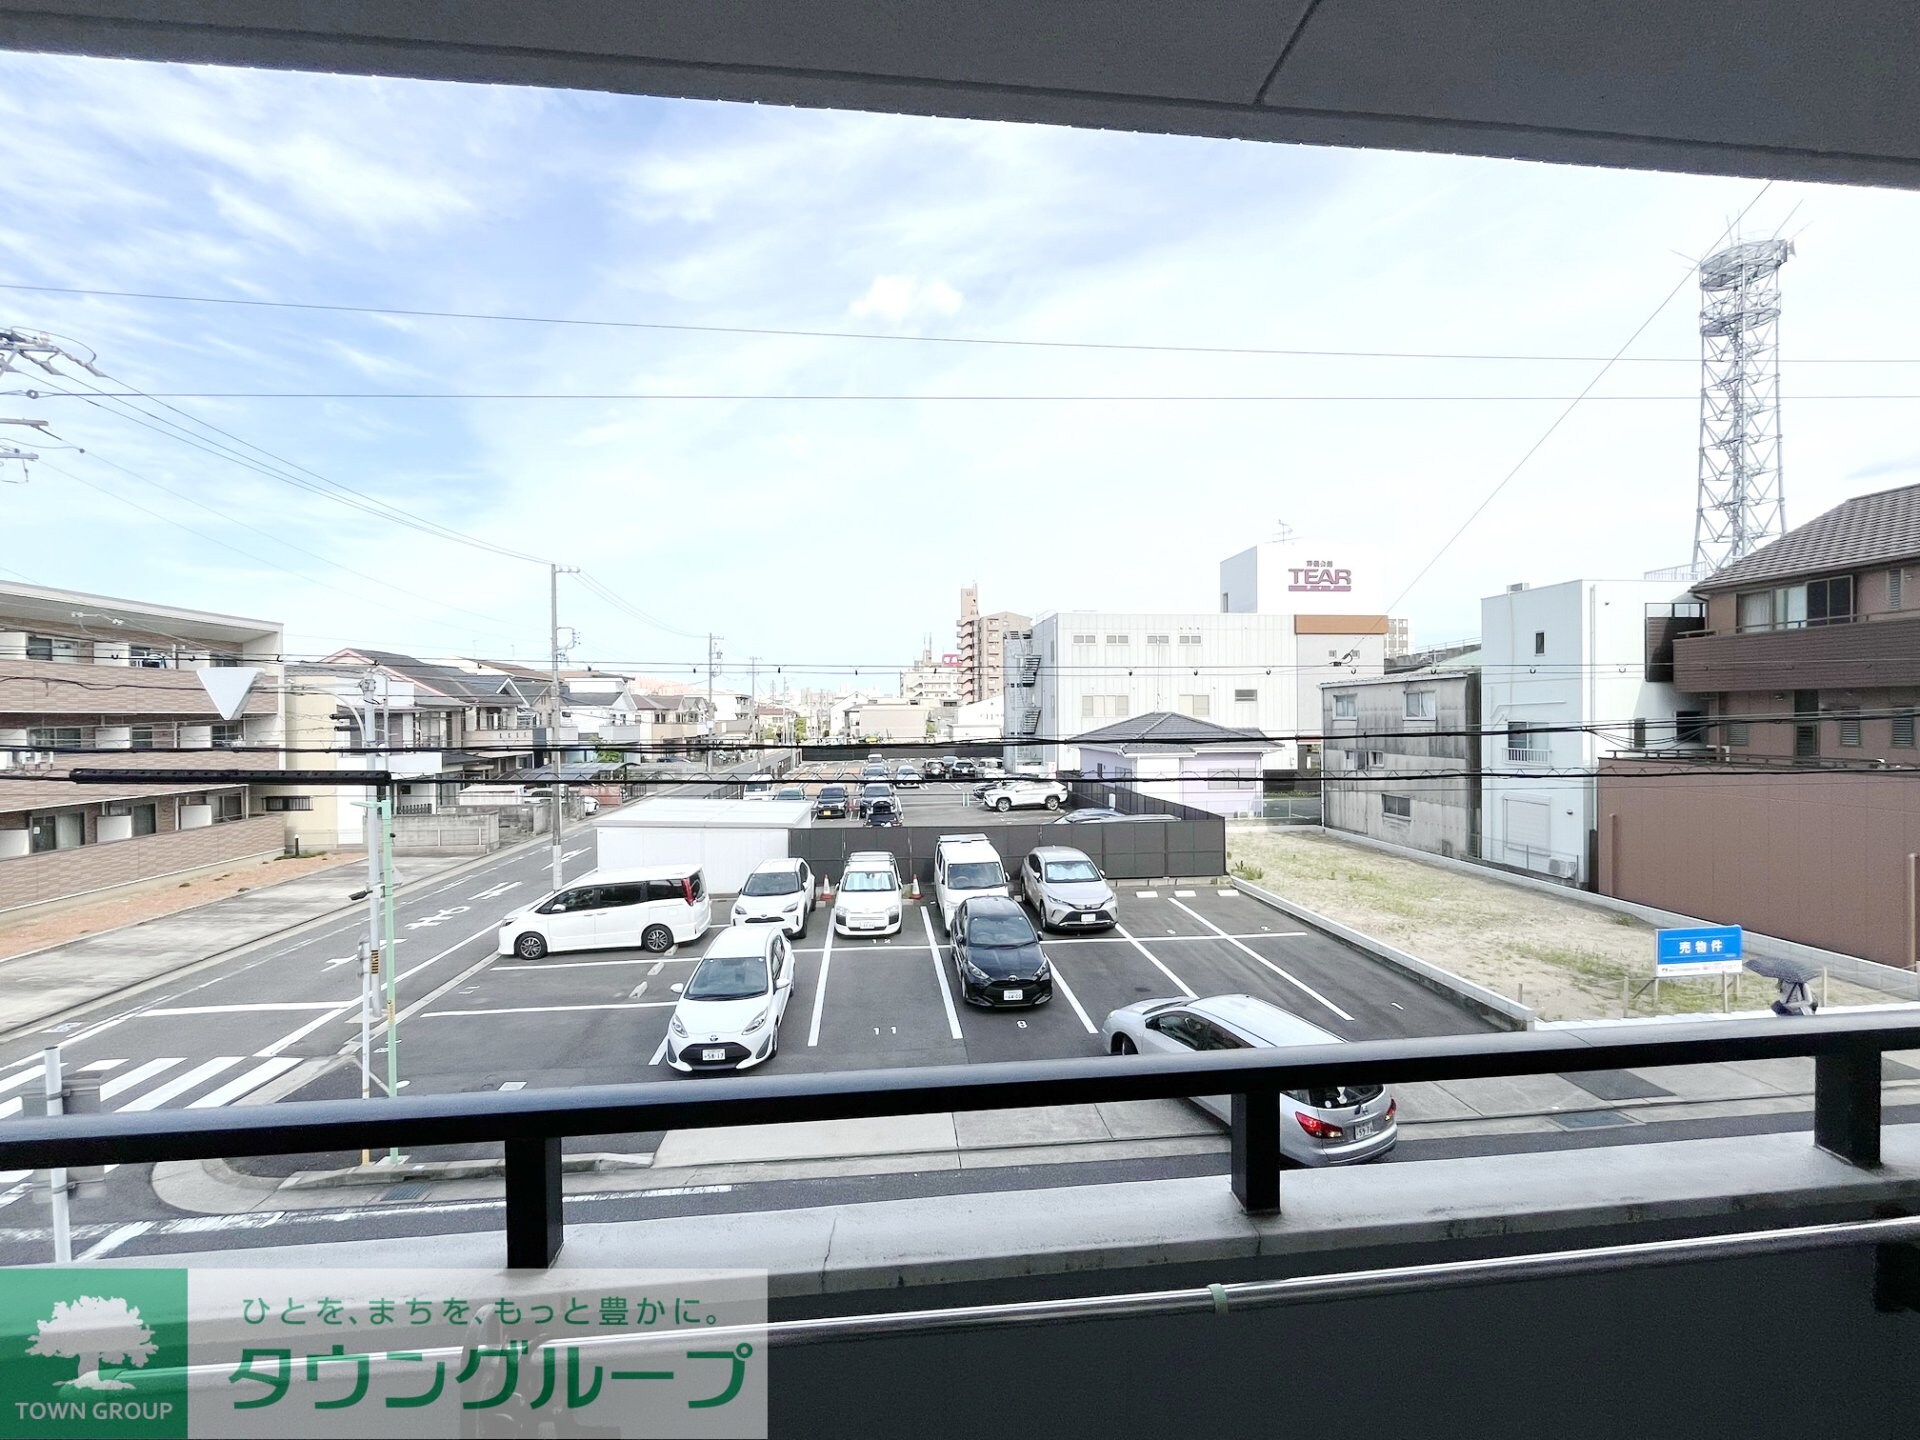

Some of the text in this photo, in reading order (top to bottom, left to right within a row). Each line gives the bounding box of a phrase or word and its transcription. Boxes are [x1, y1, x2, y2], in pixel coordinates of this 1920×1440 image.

[1288, 568, 1352, 585] TEAR
[1679, 938, 1723, 954] 売物件
[873, 1026, 897, 1035] 11
